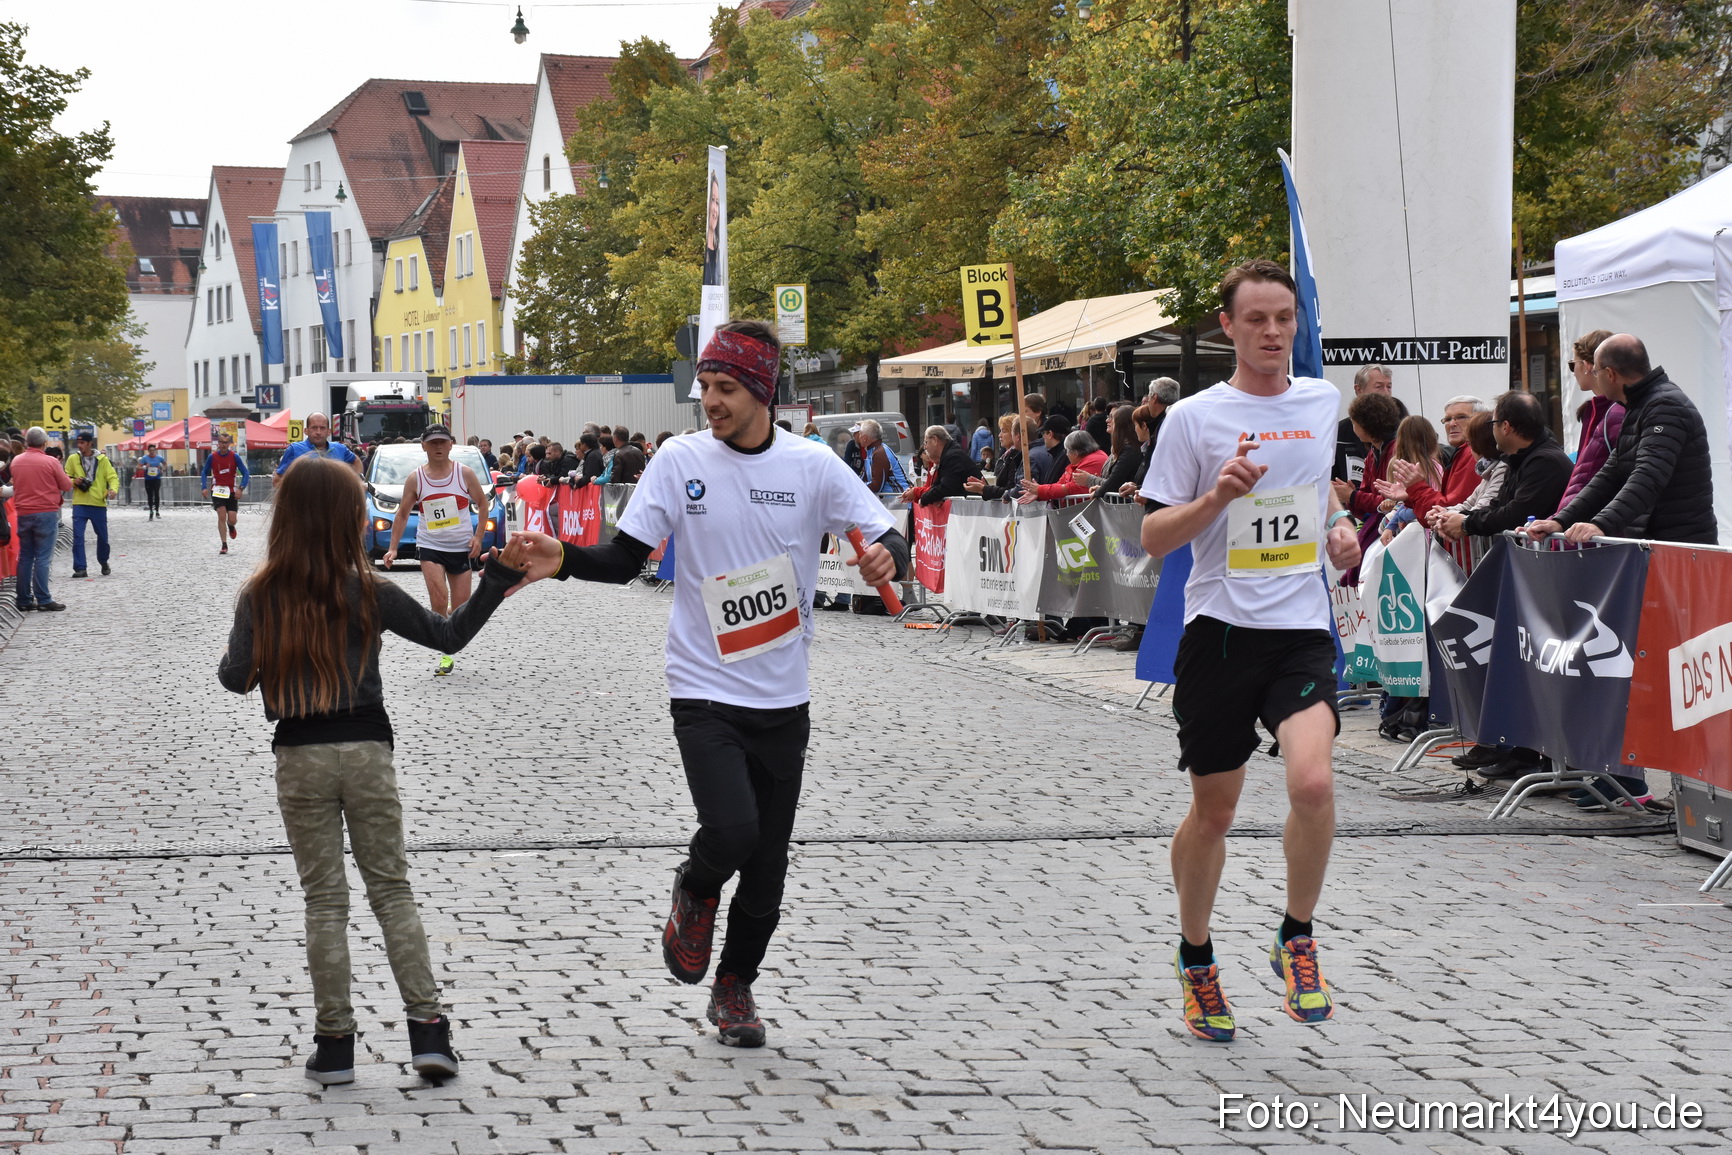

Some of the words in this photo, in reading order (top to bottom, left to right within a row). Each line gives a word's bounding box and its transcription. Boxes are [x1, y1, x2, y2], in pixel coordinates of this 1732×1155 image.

[967, 267, 1008, 283] Block
[1563, 275, 1596, 289] SOLUTIONS
[1597, 272, 1613, 282] YOUR
[1613, 269, 1628, 278] WAY.
[976, 289, 1004, 328] B
[404, 310, 419, 327] HOTEL
[1322, 340, 1506, 363] www.MINI-Partl.de
[46, 395, 67, 403] Block
[49, 405, 63, 423] C
[291, 427, 300, 438] D
[1259, 430, 1316, 441] KLEBL
[750, 489, 796, 503] BOCK
[1264, 494, 1294, 505] BOCK
[433, 507, 446, 520] 61
[1251, 514, 1299, 543] 112
[1260, 552, 1290, 562] Marco
[736, 568, 769, 585] BOCK
[722, 584, 787, 626] 8005
[1400, 637, 1416, 646] Service
[1681, 651, 1712, 710] DAS
